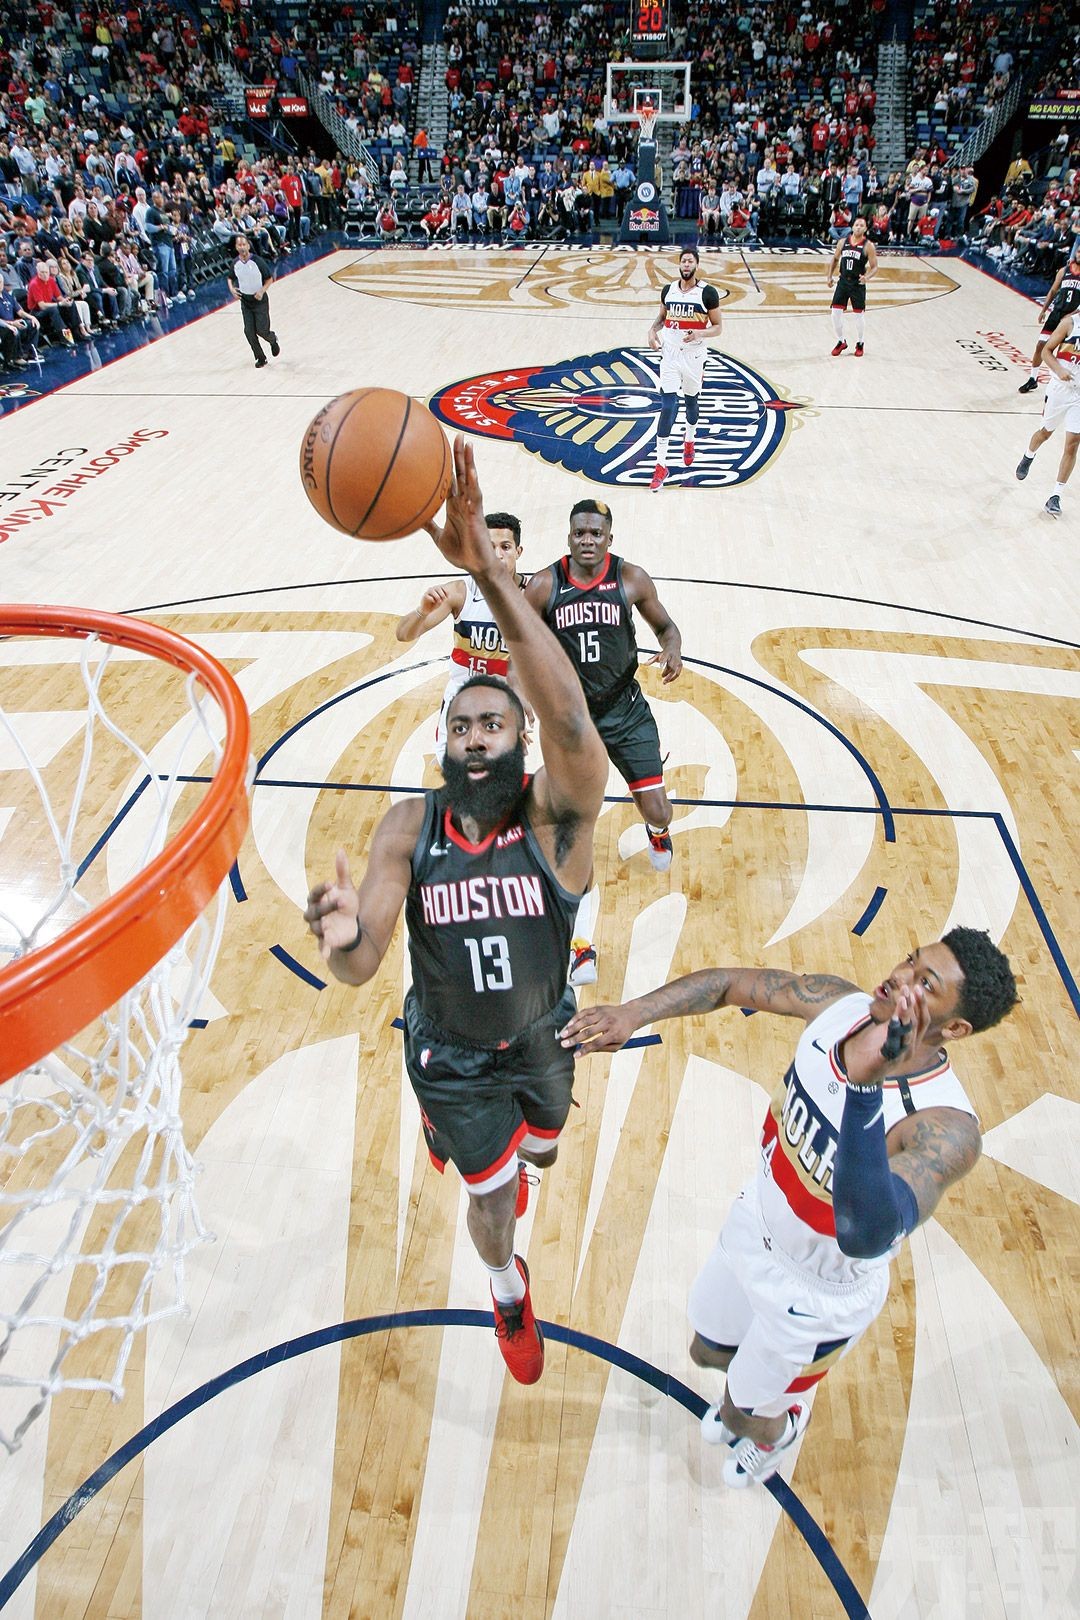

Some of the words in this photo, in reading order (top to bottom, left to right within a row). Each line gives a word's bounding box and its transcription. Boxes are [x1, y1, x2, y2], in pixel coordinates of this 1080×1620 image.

[638, 7, 662, 31] 20
[642, 33, 667, 41] TISSOT
[1029, 104, 1042, 113] BIG
[1062, 105, 1075, 114] BIG
[629, 222, 644, 231] Red
[644, 222, 659, 231] Bull
[427, 243, 516, 251] NEW
[524, 243, 684, 252] ORLEANS
[696, 245, 837, 255] PELICAN
[846, 259, 854, 270] 10
[1066, 290, 1073, 303] 3
[669, 303, 695, 318] NOLA
[955, 338, 1009, 373] CENTER
[453, 375, 520, 427] PELICANS
[42, 428, 169, 498] SMOOTHIE
[0, 447, 88, 508] CENTE
[555, 602, 621, 630] HOUSTON
[470, 625, 509, 654] NOL
[577, 631, 600, 663] 15
[468, 657, 488, 677] 15
[420, 875, 546, 926] HOUSTON
[464, 935, 513, 993] 13
